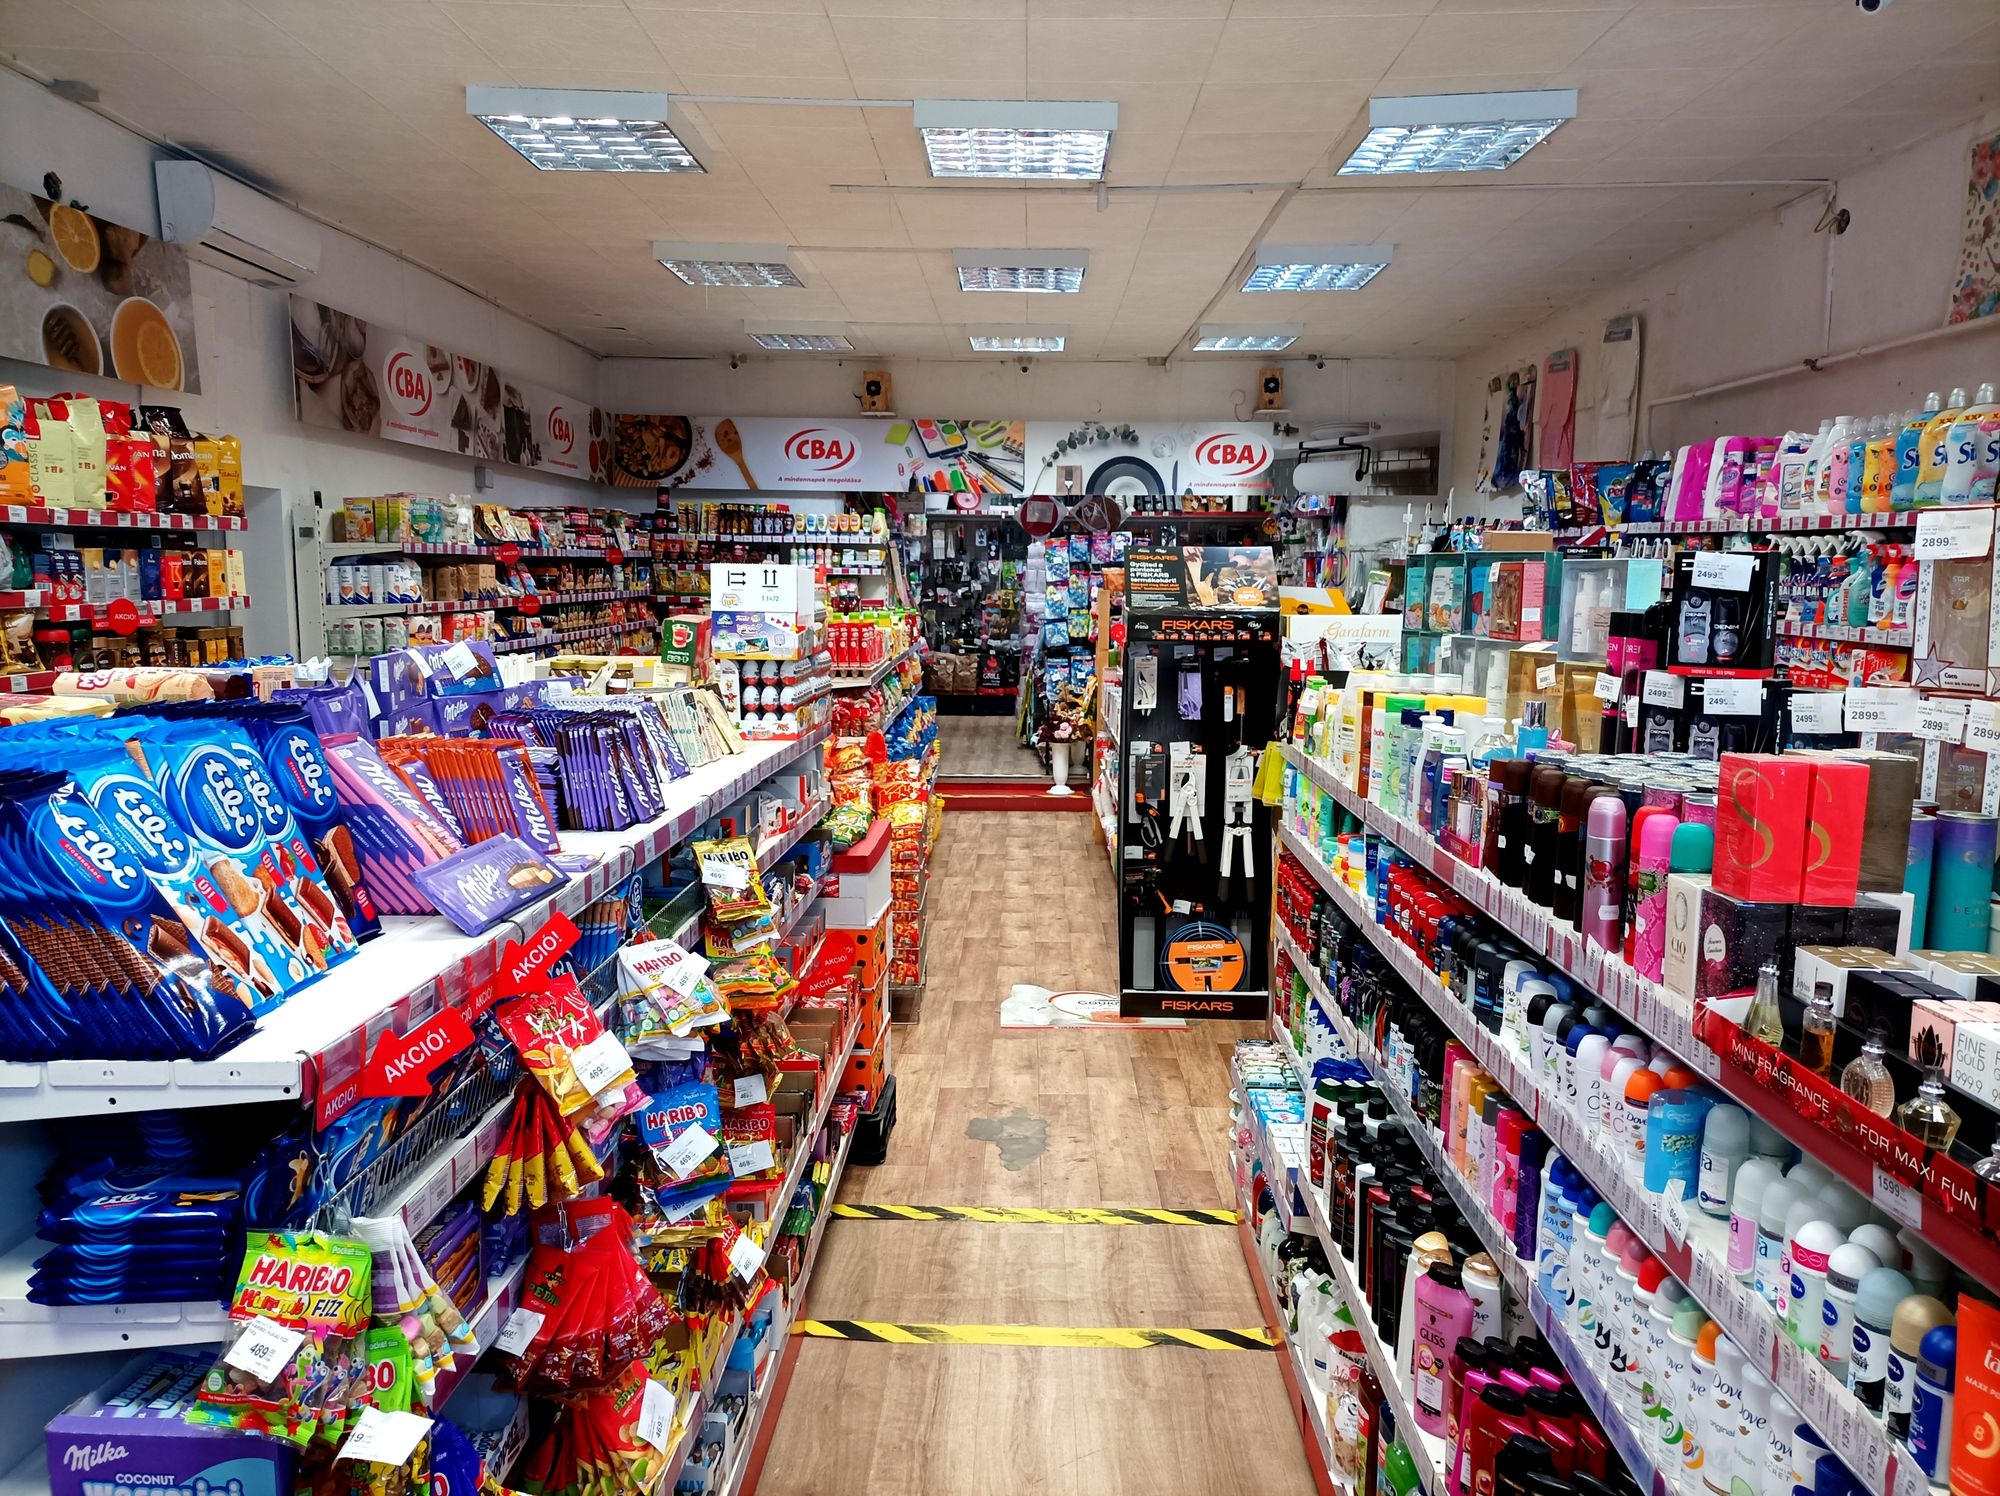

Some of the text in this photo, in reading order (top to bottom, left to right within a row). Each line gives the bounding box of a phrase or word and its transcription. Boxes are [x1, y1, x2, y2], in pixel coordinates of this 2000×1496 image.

[395, 367, 426, 402] CBA
[552, 417, 570, 442] CBA
[796, 439, 843, 459] CBA
[1207, 444, 1254, 464] CBA
[29, 442, 40, 483] CLASSIC
[106, 464, 127, 472] VÁN
[218, 468, 240, 481] Family
[827, 476, 862, 484] megoldása
[1922, 537, 1950, 547] 2899
[1697, 570, 1718, 579] 2499
[1952, 575, 1970, 583] STAR
[114, 612, 137, 621] AKCIÓ!
[1162, 620, 1234, 630] FISKARS
[1323, 620, 1390, 641] Garafarm
[1868, 657, 1894, 673] Fine
[1648, 689, 1667, 698] 2499
[444, 699, 469, 722] Milka
[1795, 714, 1813, 723] 2499
[1851, 711, 1879, 720] 2899
[1922, 719, 1943, 731] 2899
[1973, 726, 2000, 740] 2899
[356, 756, 431, 827] Milka
[151, 798, 177, 828] ROSHEN
[416, 773, 463, 838] Milka
[513, 774, 550, 844] Milka
[457, 861, 500, 907] Milka
[511, 931, 563, 983] AKCIÓ!
[632, 952, 684, 976] HARIBO
[824, 955, 848, 966] AKCIÓ!
[679, 975, 689, 988] 469
[809, 976, 836, 992] AKCIÓ!
[1161, 1001, 1234, 1011] FISKARS
[1958, 1033, 1987, 1056] FINE
[384, 1027, 451, 1084] AKCIÓ!
[1957, 1049, 1985, 1072] GOLD
[589, 1065, 604, 1080] 469
[324, 1083, 357, 1119] AKCIÓ!
[646, 1102, 708, 1131] HARIBO
[722, 1118, 770, 1132] HARIBO
[1731, 1038, 1978, 1211] MINI FRAGRANCE FOR MAXI FUN
[679, 1154, 692, 1167] 469
[1877, 1174, 1901, 1198] 1599
[1584, 1252, 1601, 1268] ove
[250, 1255, 351, 1295] HARIBO
[1836, 1276, 1858, 1290] ACTIV
[1615, 1290, 1632, 1305] ove
[1473, 1308, 1489, 1322] ove
[1420, 1327, 1446, 1349] GLISS
[1852, 1332, 1867, 1347] NIVEA
[250, 1342, 269, 1359] 489
[1667, 1356, 1684, 1373] ove
[1888, 1362, 1902, 1377] NIVEA
[1965, 1375, 1988, 1394] MAXX
[1841, 1418, 1851, 1449] 1379
[1973, 1424, 1984, 1441] 8
[63, 1441, 130, 1472] Milka
[1867, 1444, 1878, 1481] 1379
[115, 1473, 175, 1486] COCONUT
